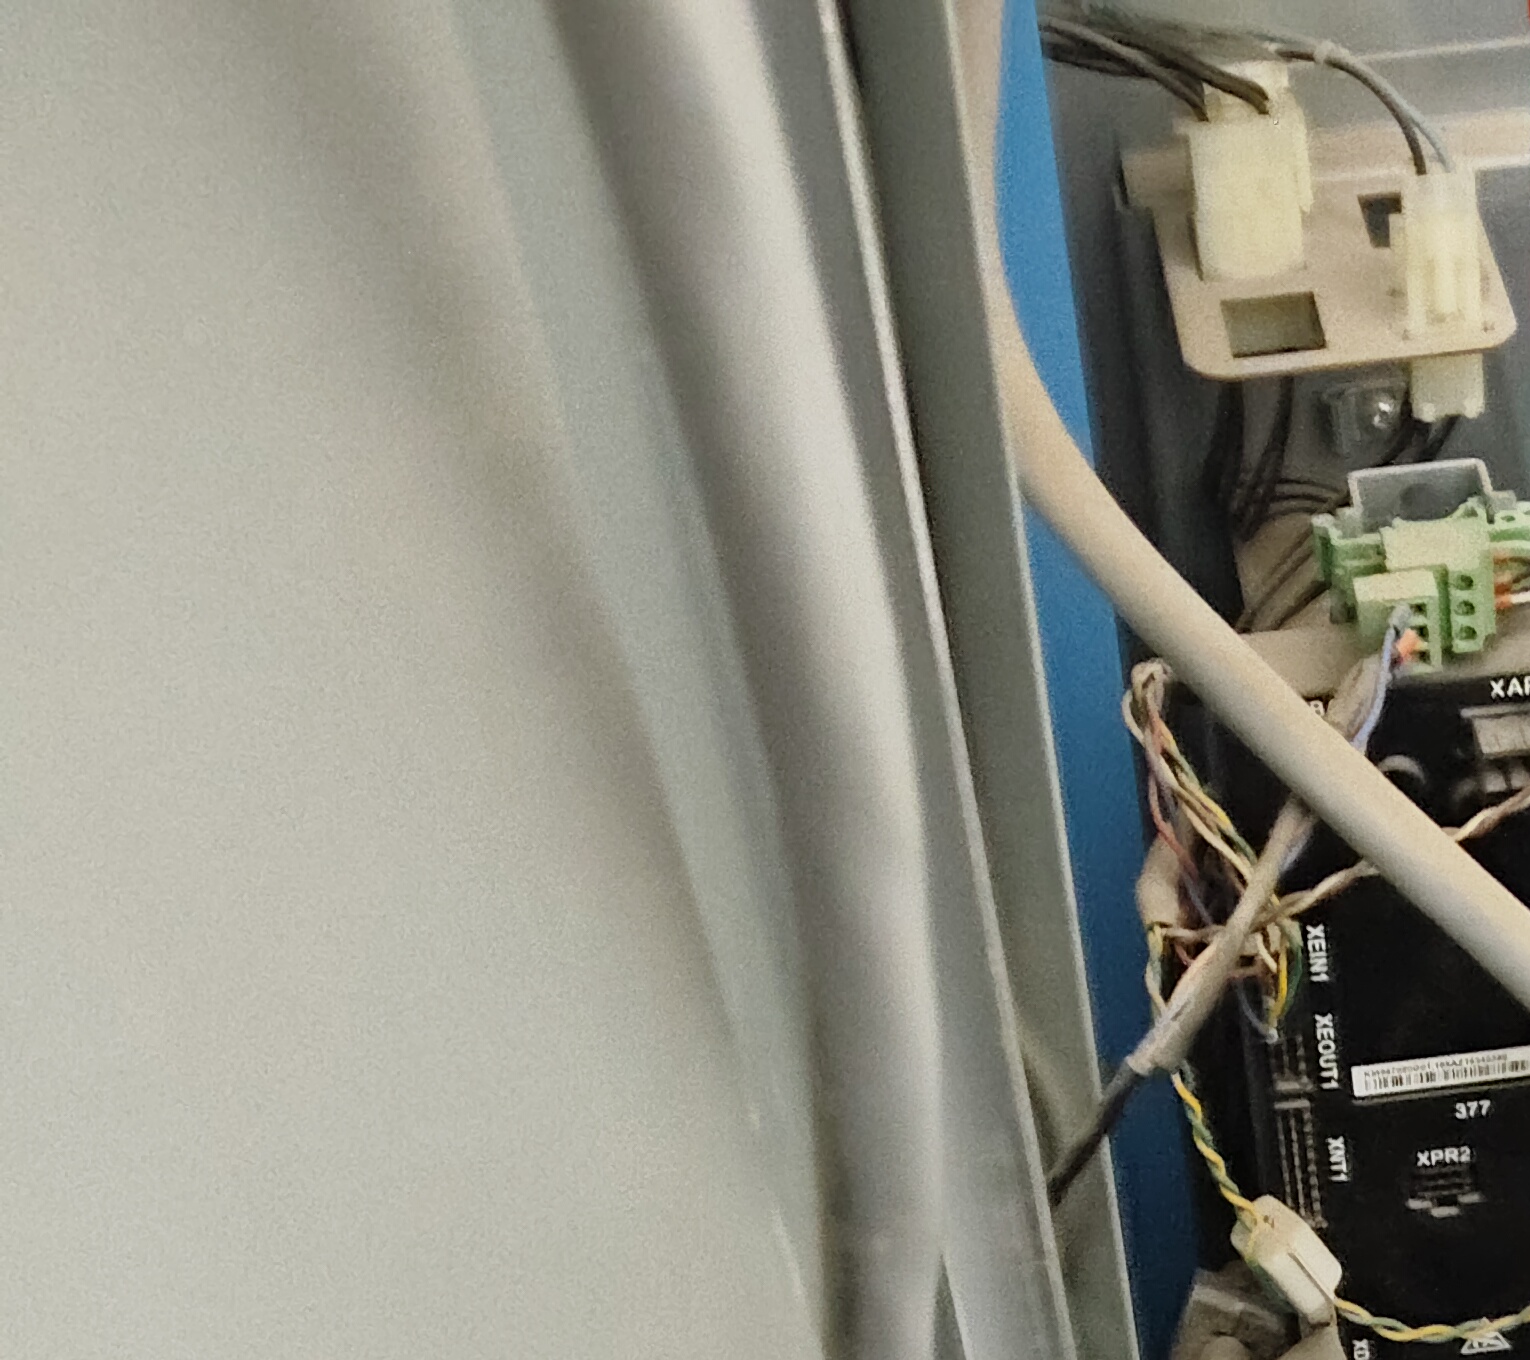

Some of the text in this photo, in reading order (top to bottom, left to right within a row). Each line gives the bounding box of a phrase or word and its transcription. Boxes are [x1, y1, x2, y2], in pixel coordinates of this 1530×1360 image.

[1306, 923, 1330, 983] XEIN1
[1314, 1012, 1339, 1091] XEOUT1
[1455, 1099, 1491, 1120] 377
[1325, 1135, 1351, 1183] XNT1
[1416, 1145, 1471, 1167] XPR2
